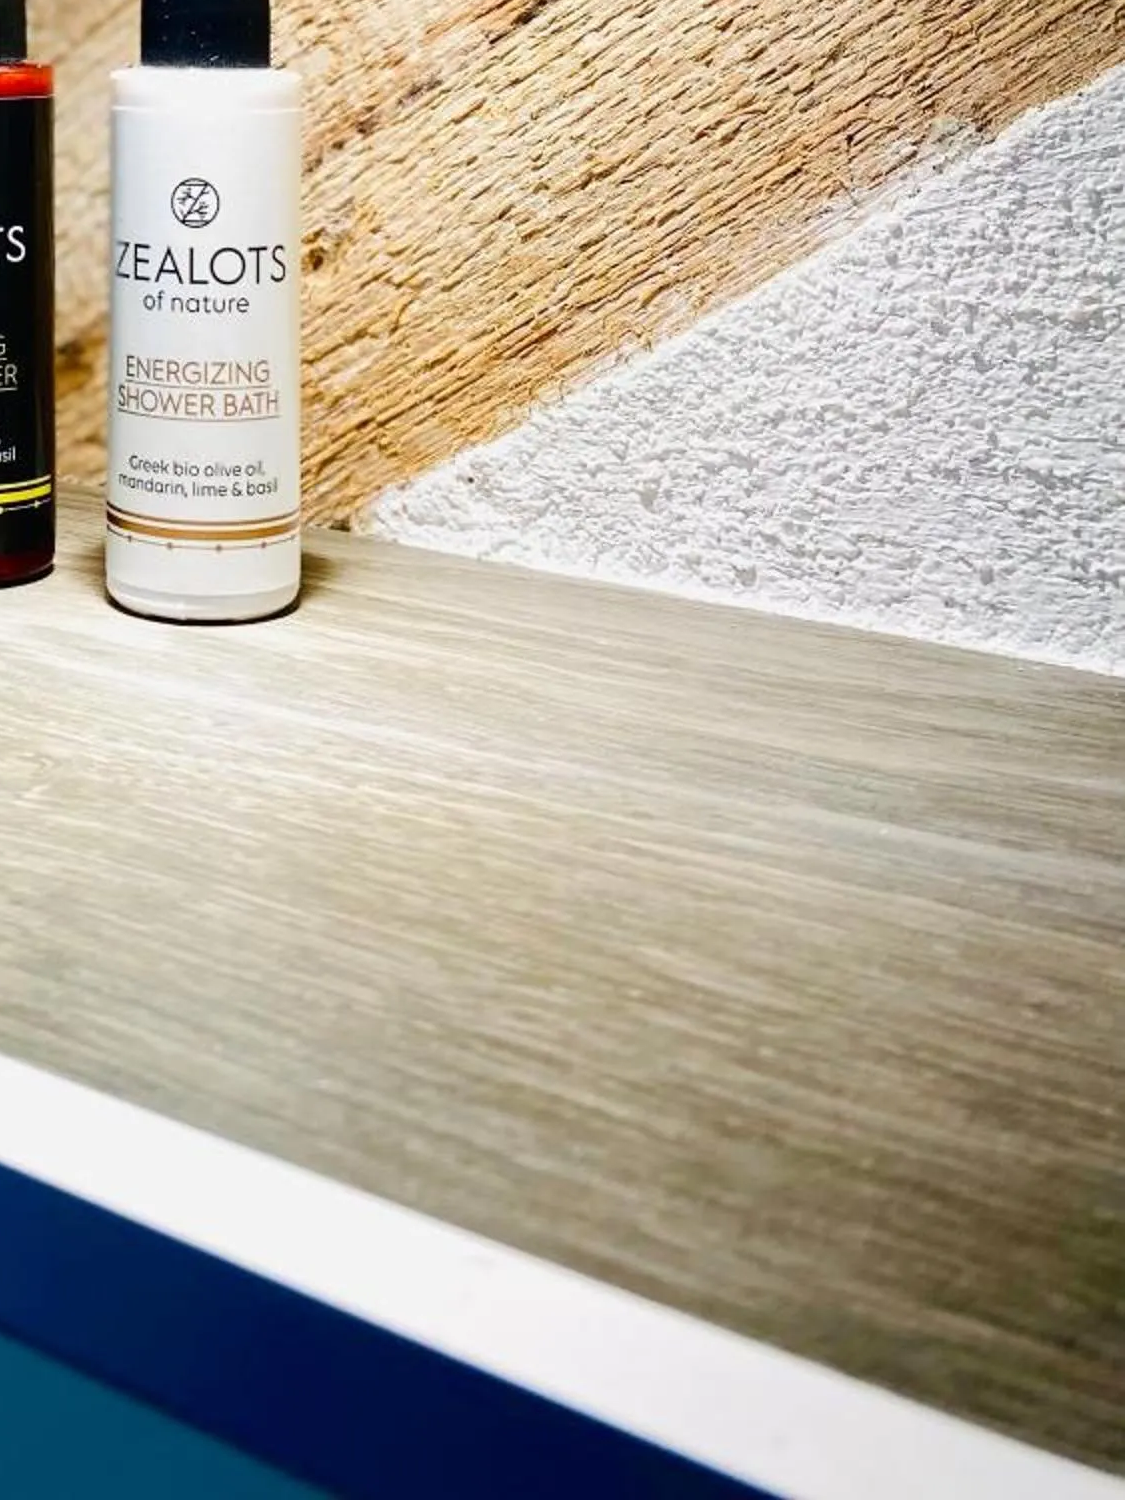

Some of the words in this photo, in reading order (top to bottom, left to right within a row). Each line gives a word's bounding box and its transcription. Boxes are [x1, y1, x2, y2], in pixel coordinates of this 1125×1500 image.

[115, 240, 287, 285] ZEALOTS
[142, 290, 166, 311] of
[170, 296, 250, 314] nature
[125, 355, 271, 385] ENERGIZING
[118, 384, 216, 417] SHOWER
[223, 390, 279, 417] BATH
[173, 459, 200, 478] bio
[204, 460, 242, 478] olive
[118, 472, 188, 498] mandarin,
[192, 482, 228, 498] lime
[231, 481, 243, 498] &
[246, 476, 279, 495] basil
